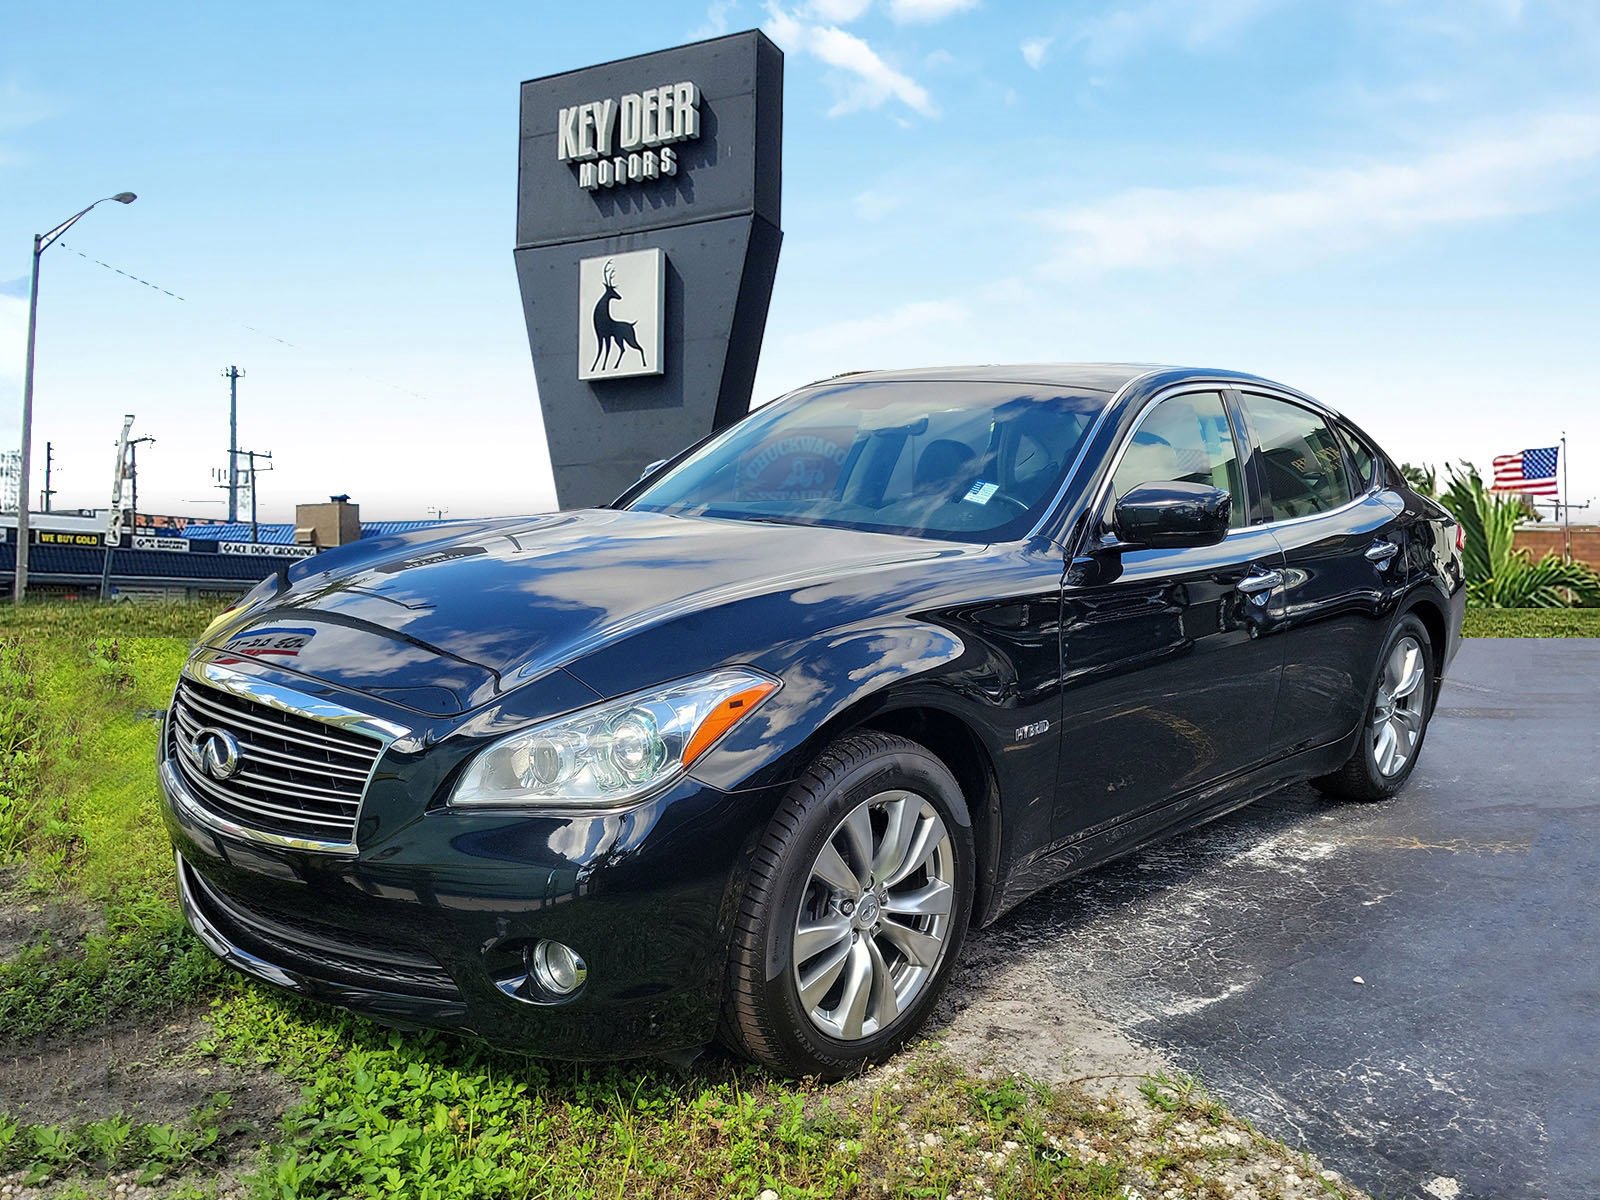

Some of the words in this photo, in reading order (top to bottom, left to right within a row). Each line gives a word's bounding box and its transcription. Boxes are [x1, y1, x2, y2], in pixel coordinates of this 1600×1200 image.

[558, 98, 616, 162] KEY
[620, 81, 699, 150] DEER
[579, 147, 677, 190] MOTORS
[746, 434, 848, 481] CHUCKWAGO
[41, 533, 55, 543] WE
[57, 534, 74, 544] BUY
[76, 535, 97, 545] GOLD
[233, 545, 247, 553] ACE
[251, 545, 270, 555] DOG
[273, 546, 314, 556] GROOMING
[1015, 719, 1050, 742] HYBRID
